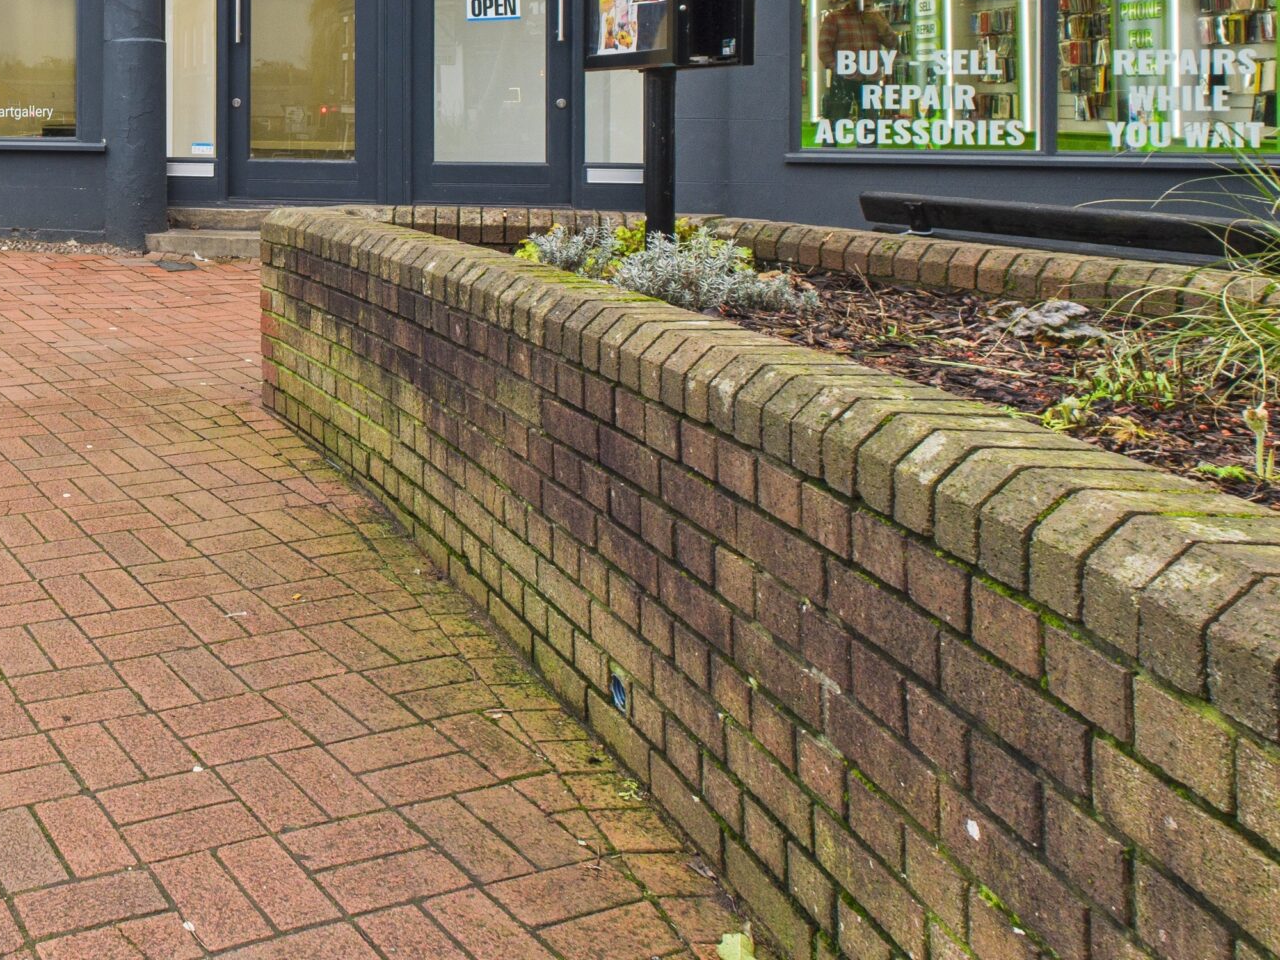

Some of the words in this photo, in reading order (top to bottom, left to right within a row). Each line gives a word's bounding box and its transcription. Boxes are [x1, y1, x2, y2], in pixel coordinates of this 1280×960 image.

[919, 0, 932, 12] SELL
[1120, 0, 1163, 23] PHONE
[916, 23, 935, 35] REPAIR
[1128, 29, 1153, 49] FOR
[837, 50, 897, 75] BUY
[932, 50, 1003, 75] SELL
[1113, 48, 1257, 76] REPAIRS
[862, 84, 975, 109] REPAIR
[1129, 85, 1231, 112] WHILE
[815, 119, 1025, 145] ACCESSORIES
[1106, 121, 1172, 148] YOU
[1183, 121, 1265, 148] WAIT
